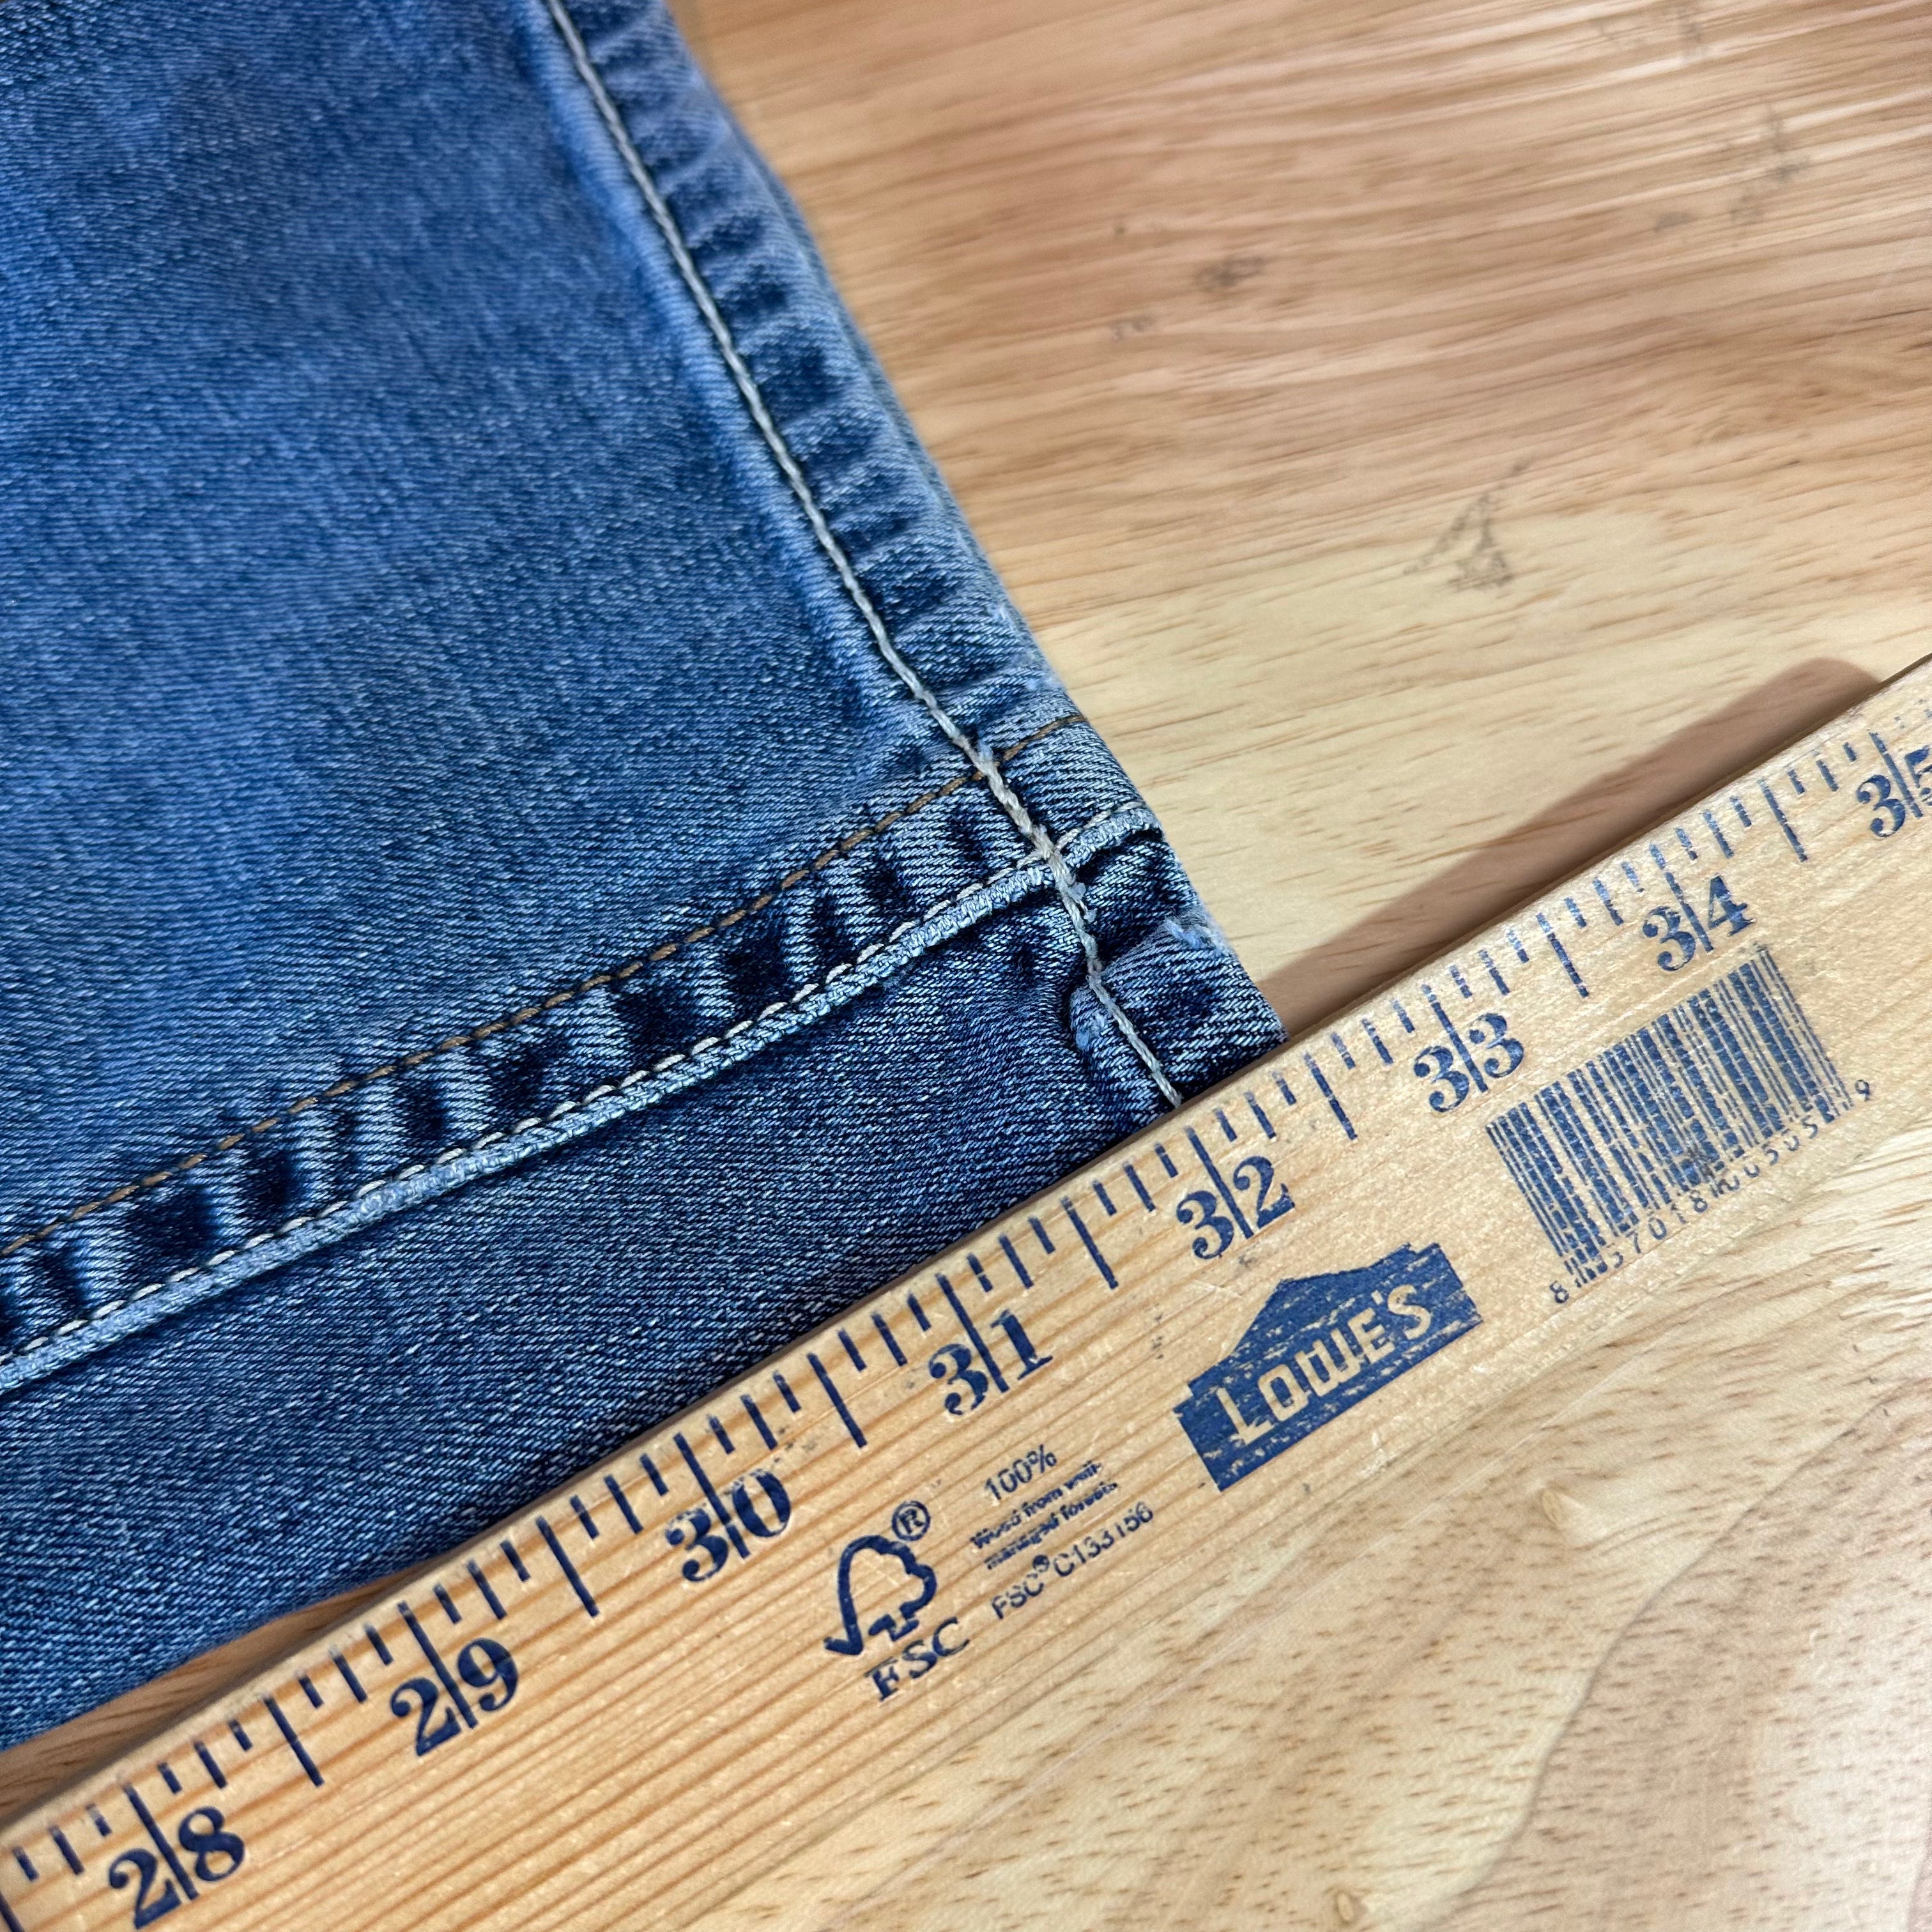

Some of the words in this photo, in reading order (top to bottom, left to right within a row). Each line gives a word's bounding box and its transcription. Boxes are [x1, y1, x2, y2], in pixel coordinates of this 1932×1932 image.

[1643, 875, 1755, 971] 34
[1413, 1013, 1524, 1112] 33
[1176, 1155, 1296, 1260] 32
[929, 1309, 1054, 1415] 31
[1216, 1284, 1432, 1446] LOWE'S
[665, 1468, 792, 1582] 30
[985, 1444, 1057, 1501] 100%
[1022, 1487, 1064, 1518] from
[390, 1637, 519, 1757] 29
[864, 1616, 970, 1702] FSC
[108, 1805, 245, 1930] 28
